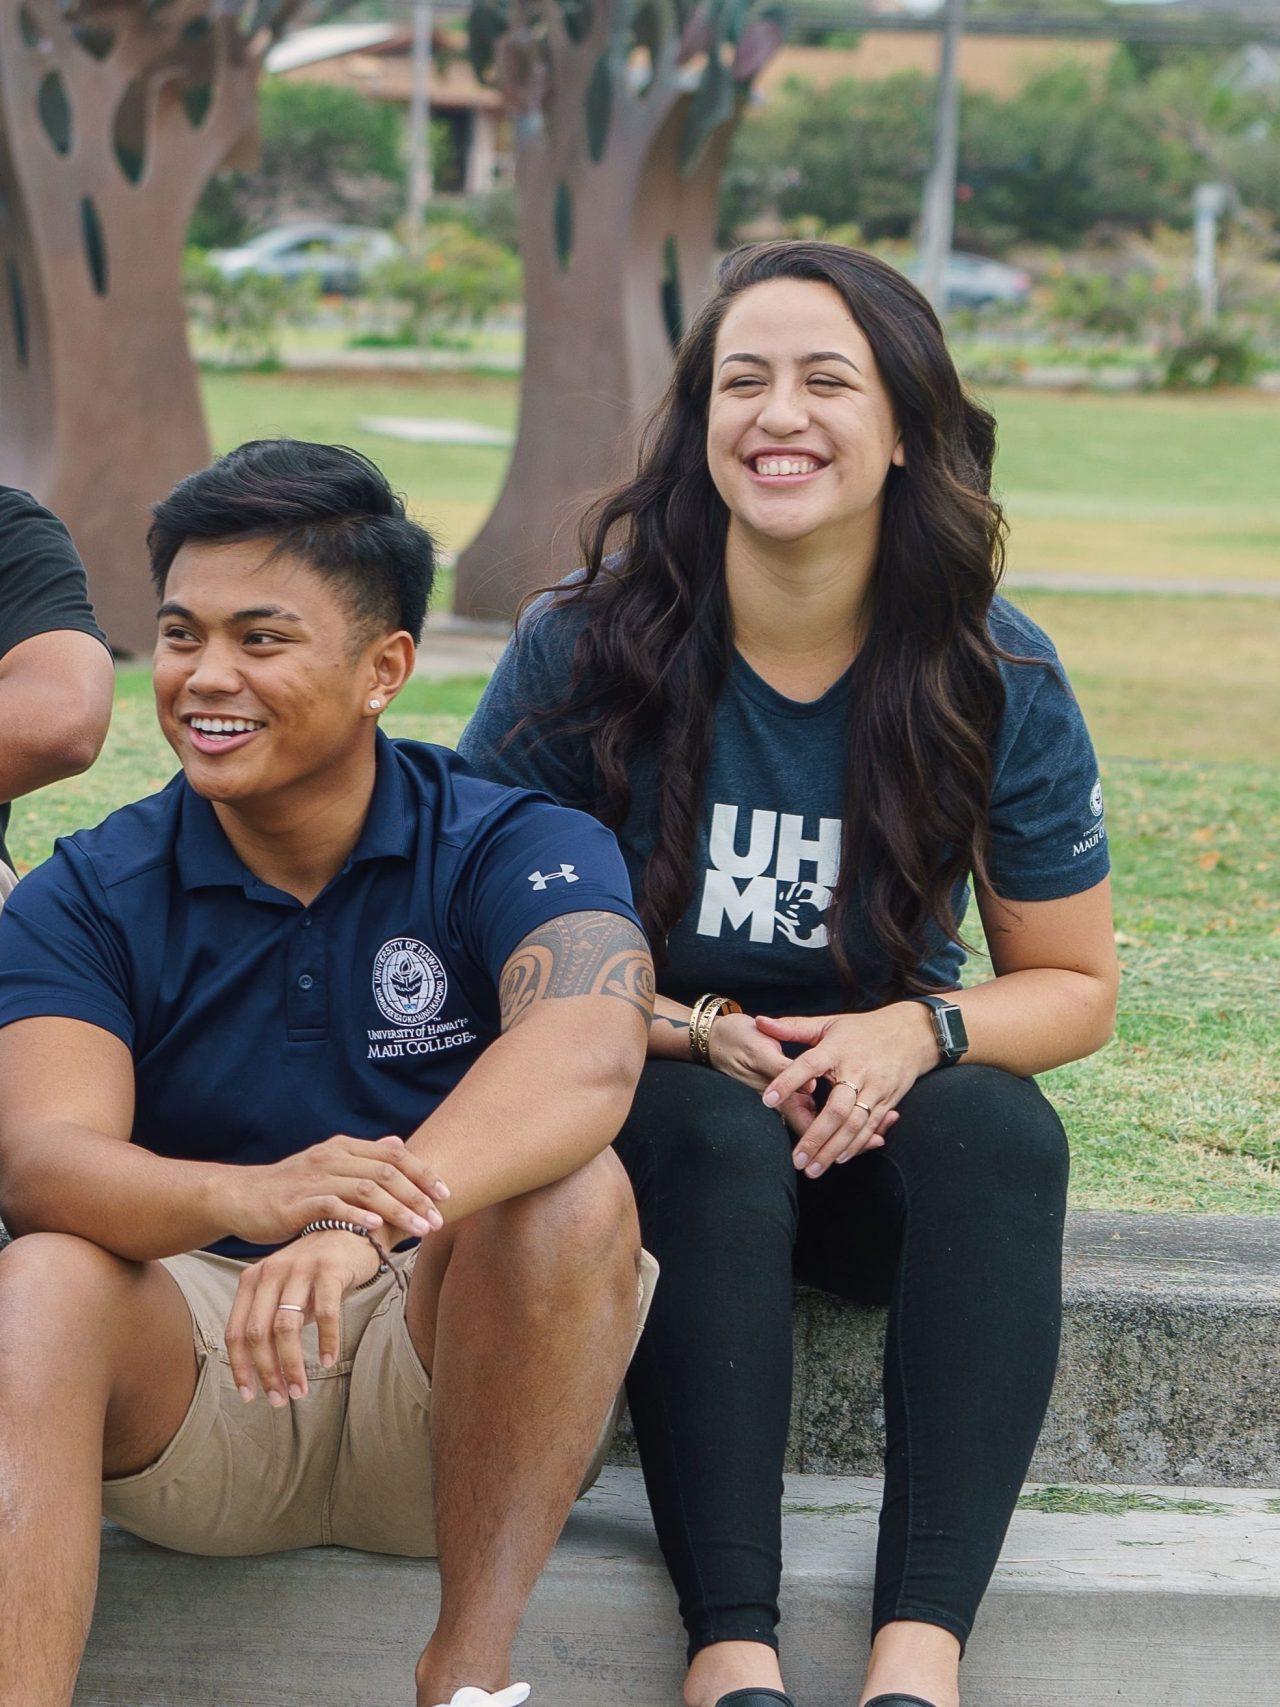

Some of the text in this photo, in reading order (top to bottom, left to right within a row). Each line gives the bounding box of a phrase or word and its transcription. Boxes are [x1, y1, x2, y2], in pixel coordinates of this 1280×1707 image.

[709, 803, 842, 887] UH
[1072, 833, 1099, 857] MAUI
[374, 940, 403, 984] UNIVERSITY
[405, 940, 419, 951] OF
[367, 1028, 414, 1041] UNIVERSITY
[415, 1024, 426, 1038] of
[367, 1031, 471, 1059] MAUI COLLEGE
